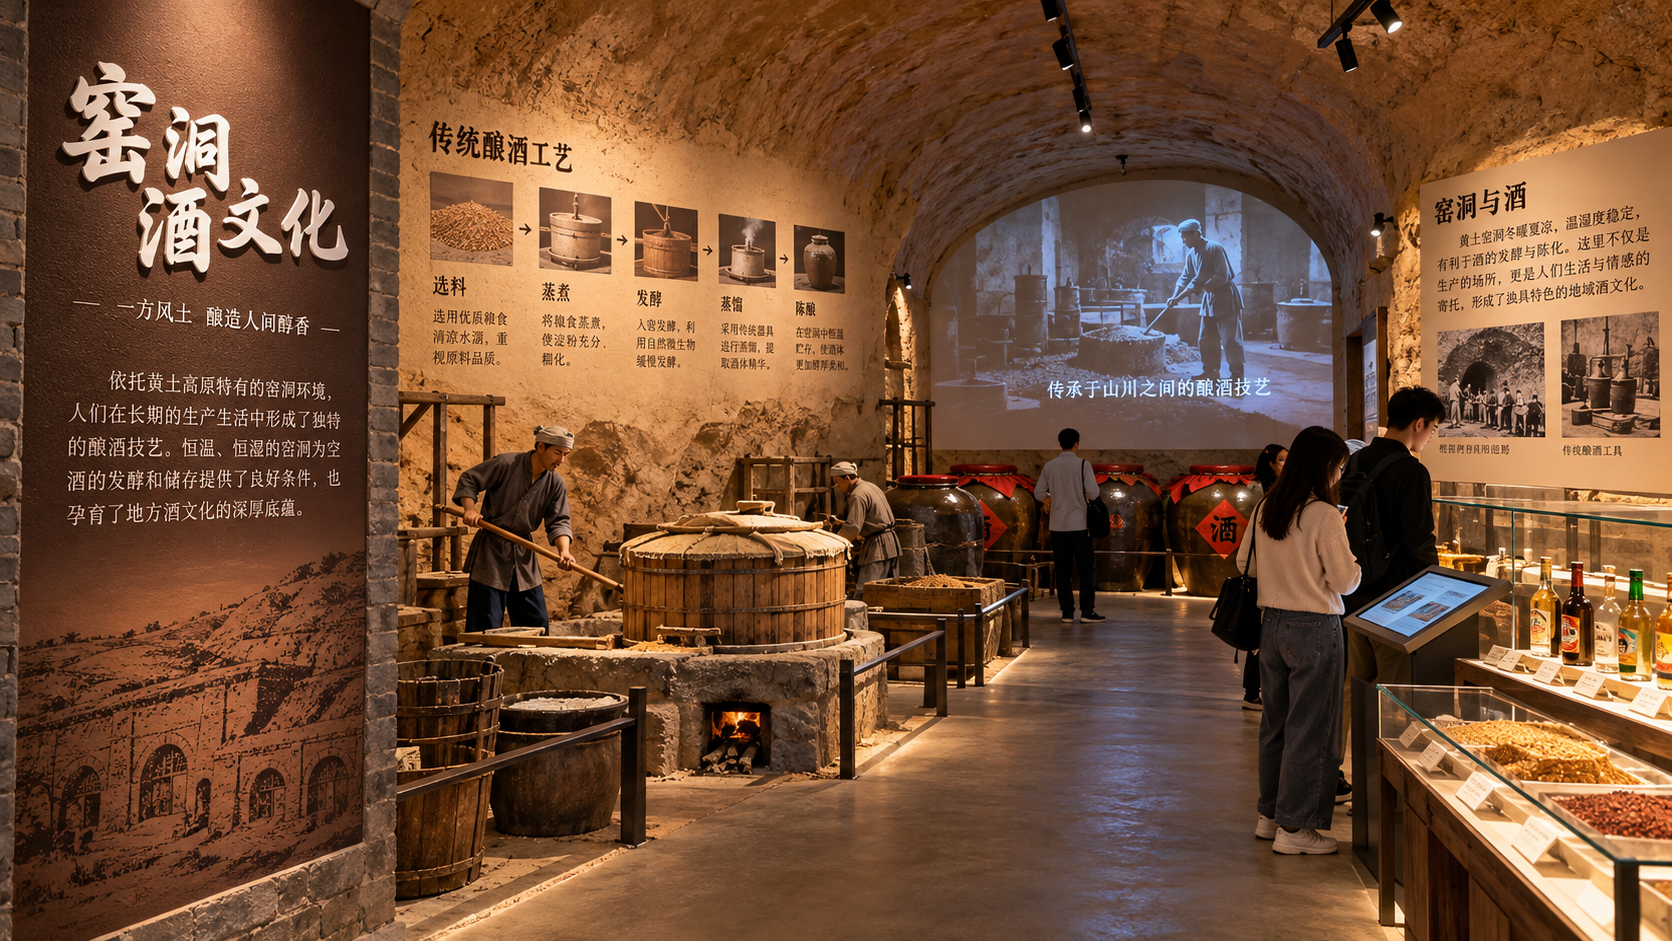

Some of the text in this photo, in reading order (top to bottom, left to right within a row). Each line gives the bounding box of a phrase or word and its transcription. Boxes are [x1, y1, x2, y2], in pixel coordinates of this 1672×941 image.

[63, 61, 230, 192] 窑洞
[429, 120, 573, 173] 传统酿酒工艺
[1435, 181, 1527, 225] 窑洞与酒
[138, 177, 348, 272] 酒文化
[433, 276, 466, 297] 选料
[542, 282, 570, 302] 蒸煮
[637, 290, 661, 307] 发酵
[117, 299, 309, 335] 一方风土 酿造人间醇香
[1047, 377, 1271, 399] 传承于山川之间的酿酒技艺
[69, 403, 340, 429] 人们在长期的生产生活中形成了独特
[1211, 516, 1237, 544] 酒
